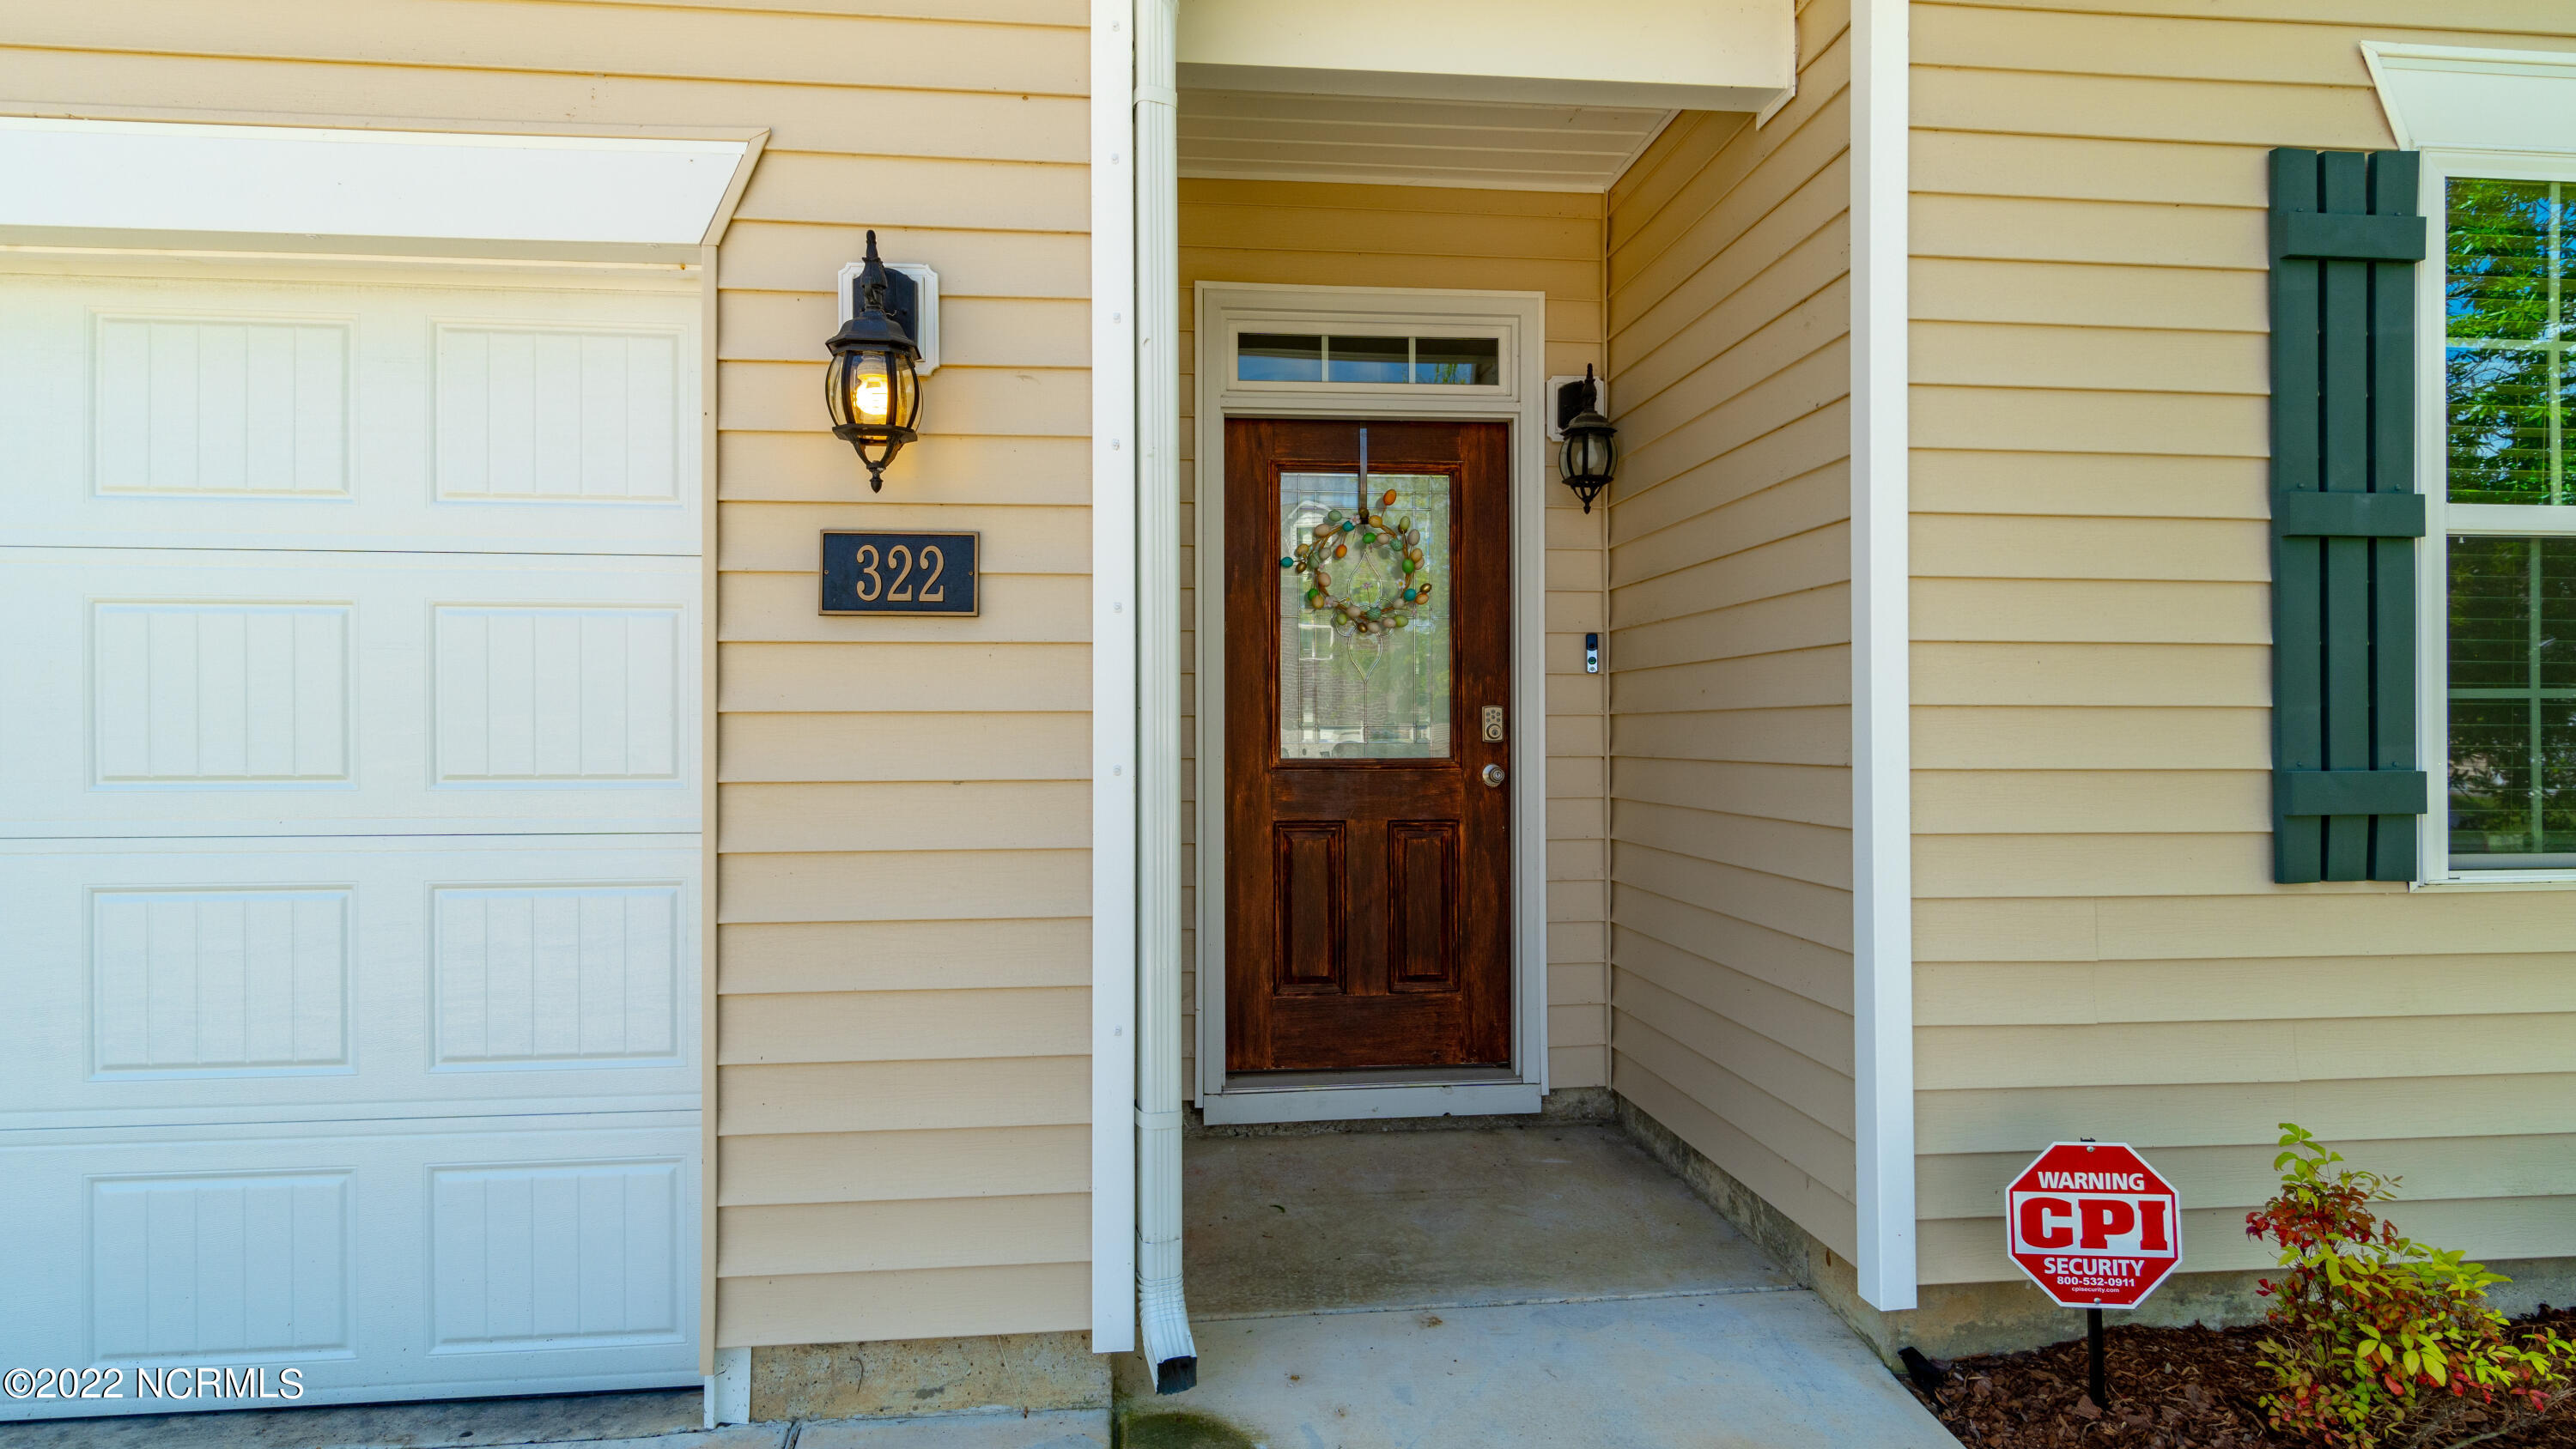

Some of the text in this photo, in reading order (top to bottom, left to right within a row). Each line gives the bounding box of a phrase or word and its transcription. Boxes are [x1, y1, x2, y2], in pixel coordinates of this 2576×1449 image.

[856, 544, 945, 602] 322
[2038, 1171, 2145, 1191] WARNING
[2020, 1197, 2168, 1251] CPI
[2044, 1257, 2145, 1276] SECURITY
[2057, 1276, 2135, 1287] 800-532-0911
